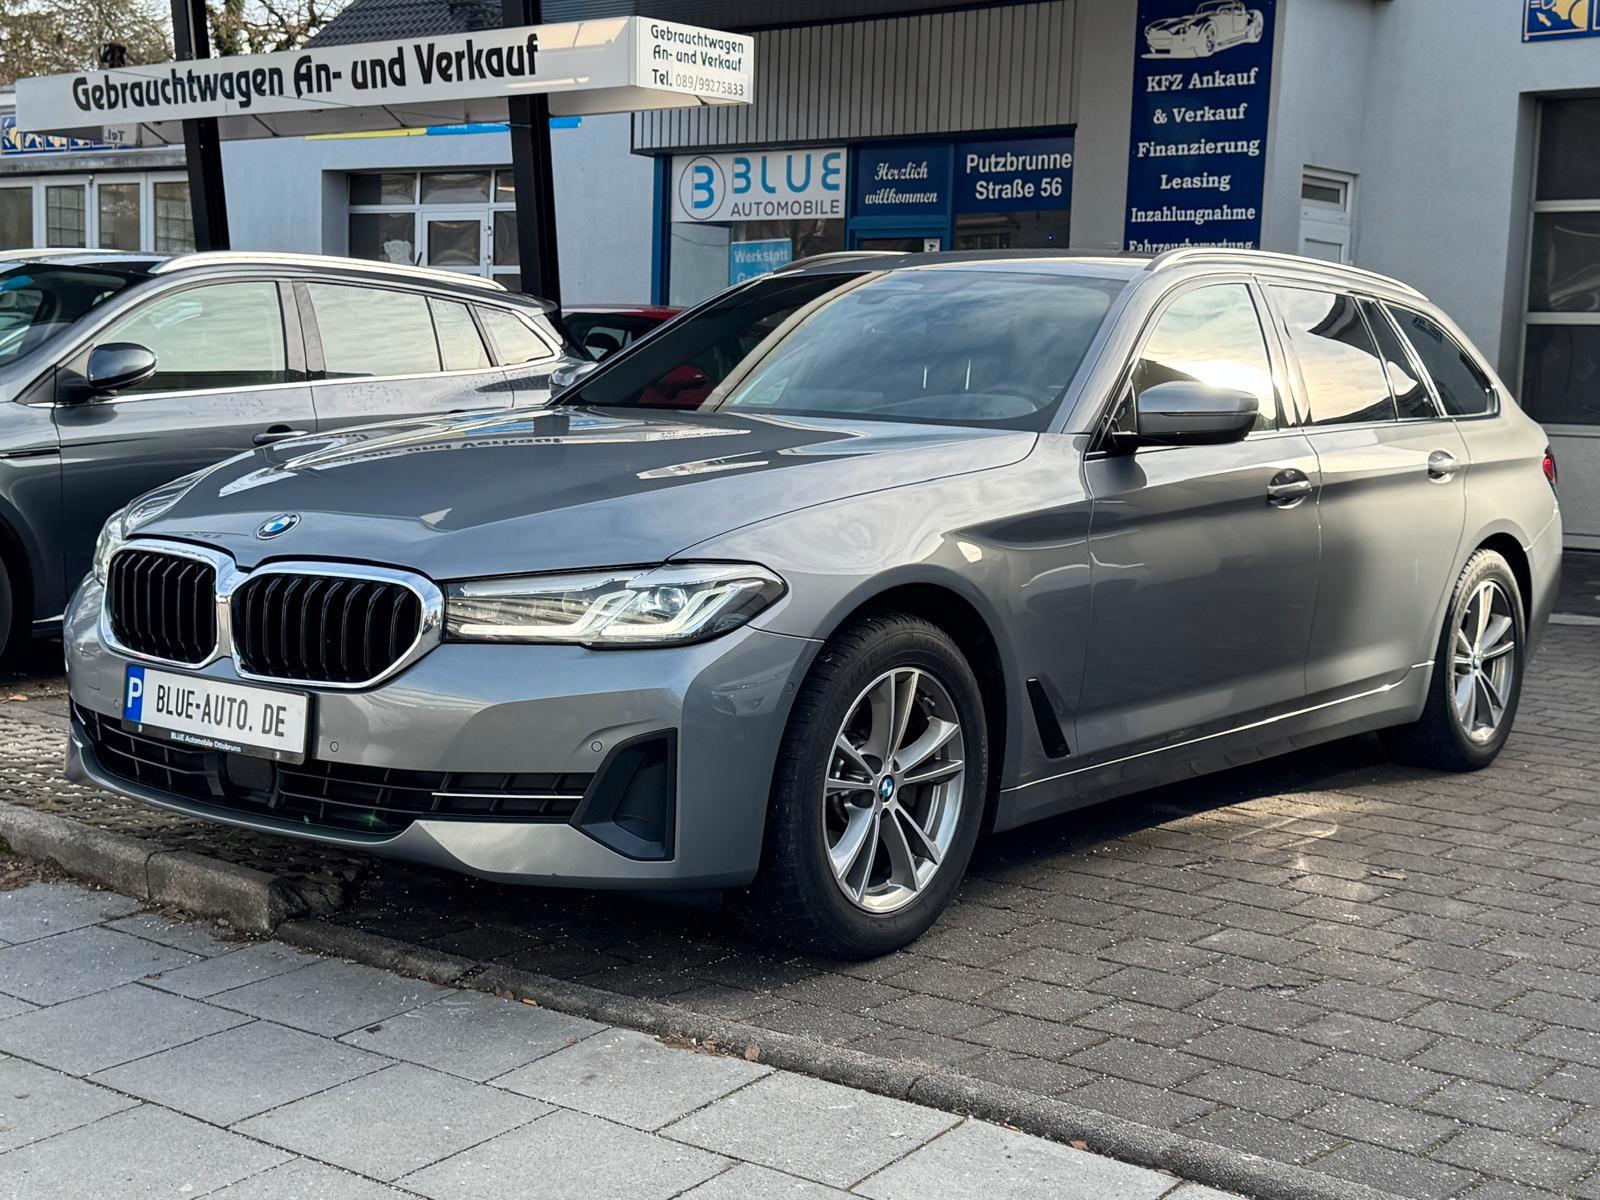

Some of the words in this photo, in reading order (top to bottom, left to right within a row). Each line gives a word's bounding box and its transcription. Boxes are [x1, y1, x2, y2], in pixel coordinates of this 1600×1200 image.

[650, 24, 744, 55] Gebrauchtwagen
[653, 44, 673, 60] An-
[676, 50, 697, 65] und
[700, 51, 742, 72] Verkauf
[72, 67, 284, 111] Gebrauchtwagen
[294, 55, 342, 98] An-
[351, 46, 407, 90] und
[413, 33, 538, 85] Verkauf
[652, 69, 673, 87] Tel.
[675, 73, 744, 96] 089/99275833
[1146, 73, 1184, 92] KFZ
[1188, 67, 1260, 89] Ankauf
[1153, 108, 1168, 124] &
[1172, 102, 1248, 123] Verkauf
[1137, 139, 1261, 158] Finanzierung
[731, 152, 841, 194] BLUE
[874, 161, 929, 181] Herzlich
[966, 151, 1073, 174] Putzbrunne
[975, 179, 1035, 200] Straße
[1040, 177, 1063, 198] 56
[1160, 172, 1232, 192] Leasing
[730, 199, 840, 217] AUTOMOBILE
[864, 188, 938, 205] willkommen
[1130, 203, 1256, 226] Inzahlungnahme
[735, 248, 789, 263] Werkstatt
[127, 676, 143, 708] P
[170, 731, 185, 742] BLUE
[185, 735, 213, 748] Automobile
[213, 740, 242, 753] Ottobrunn
